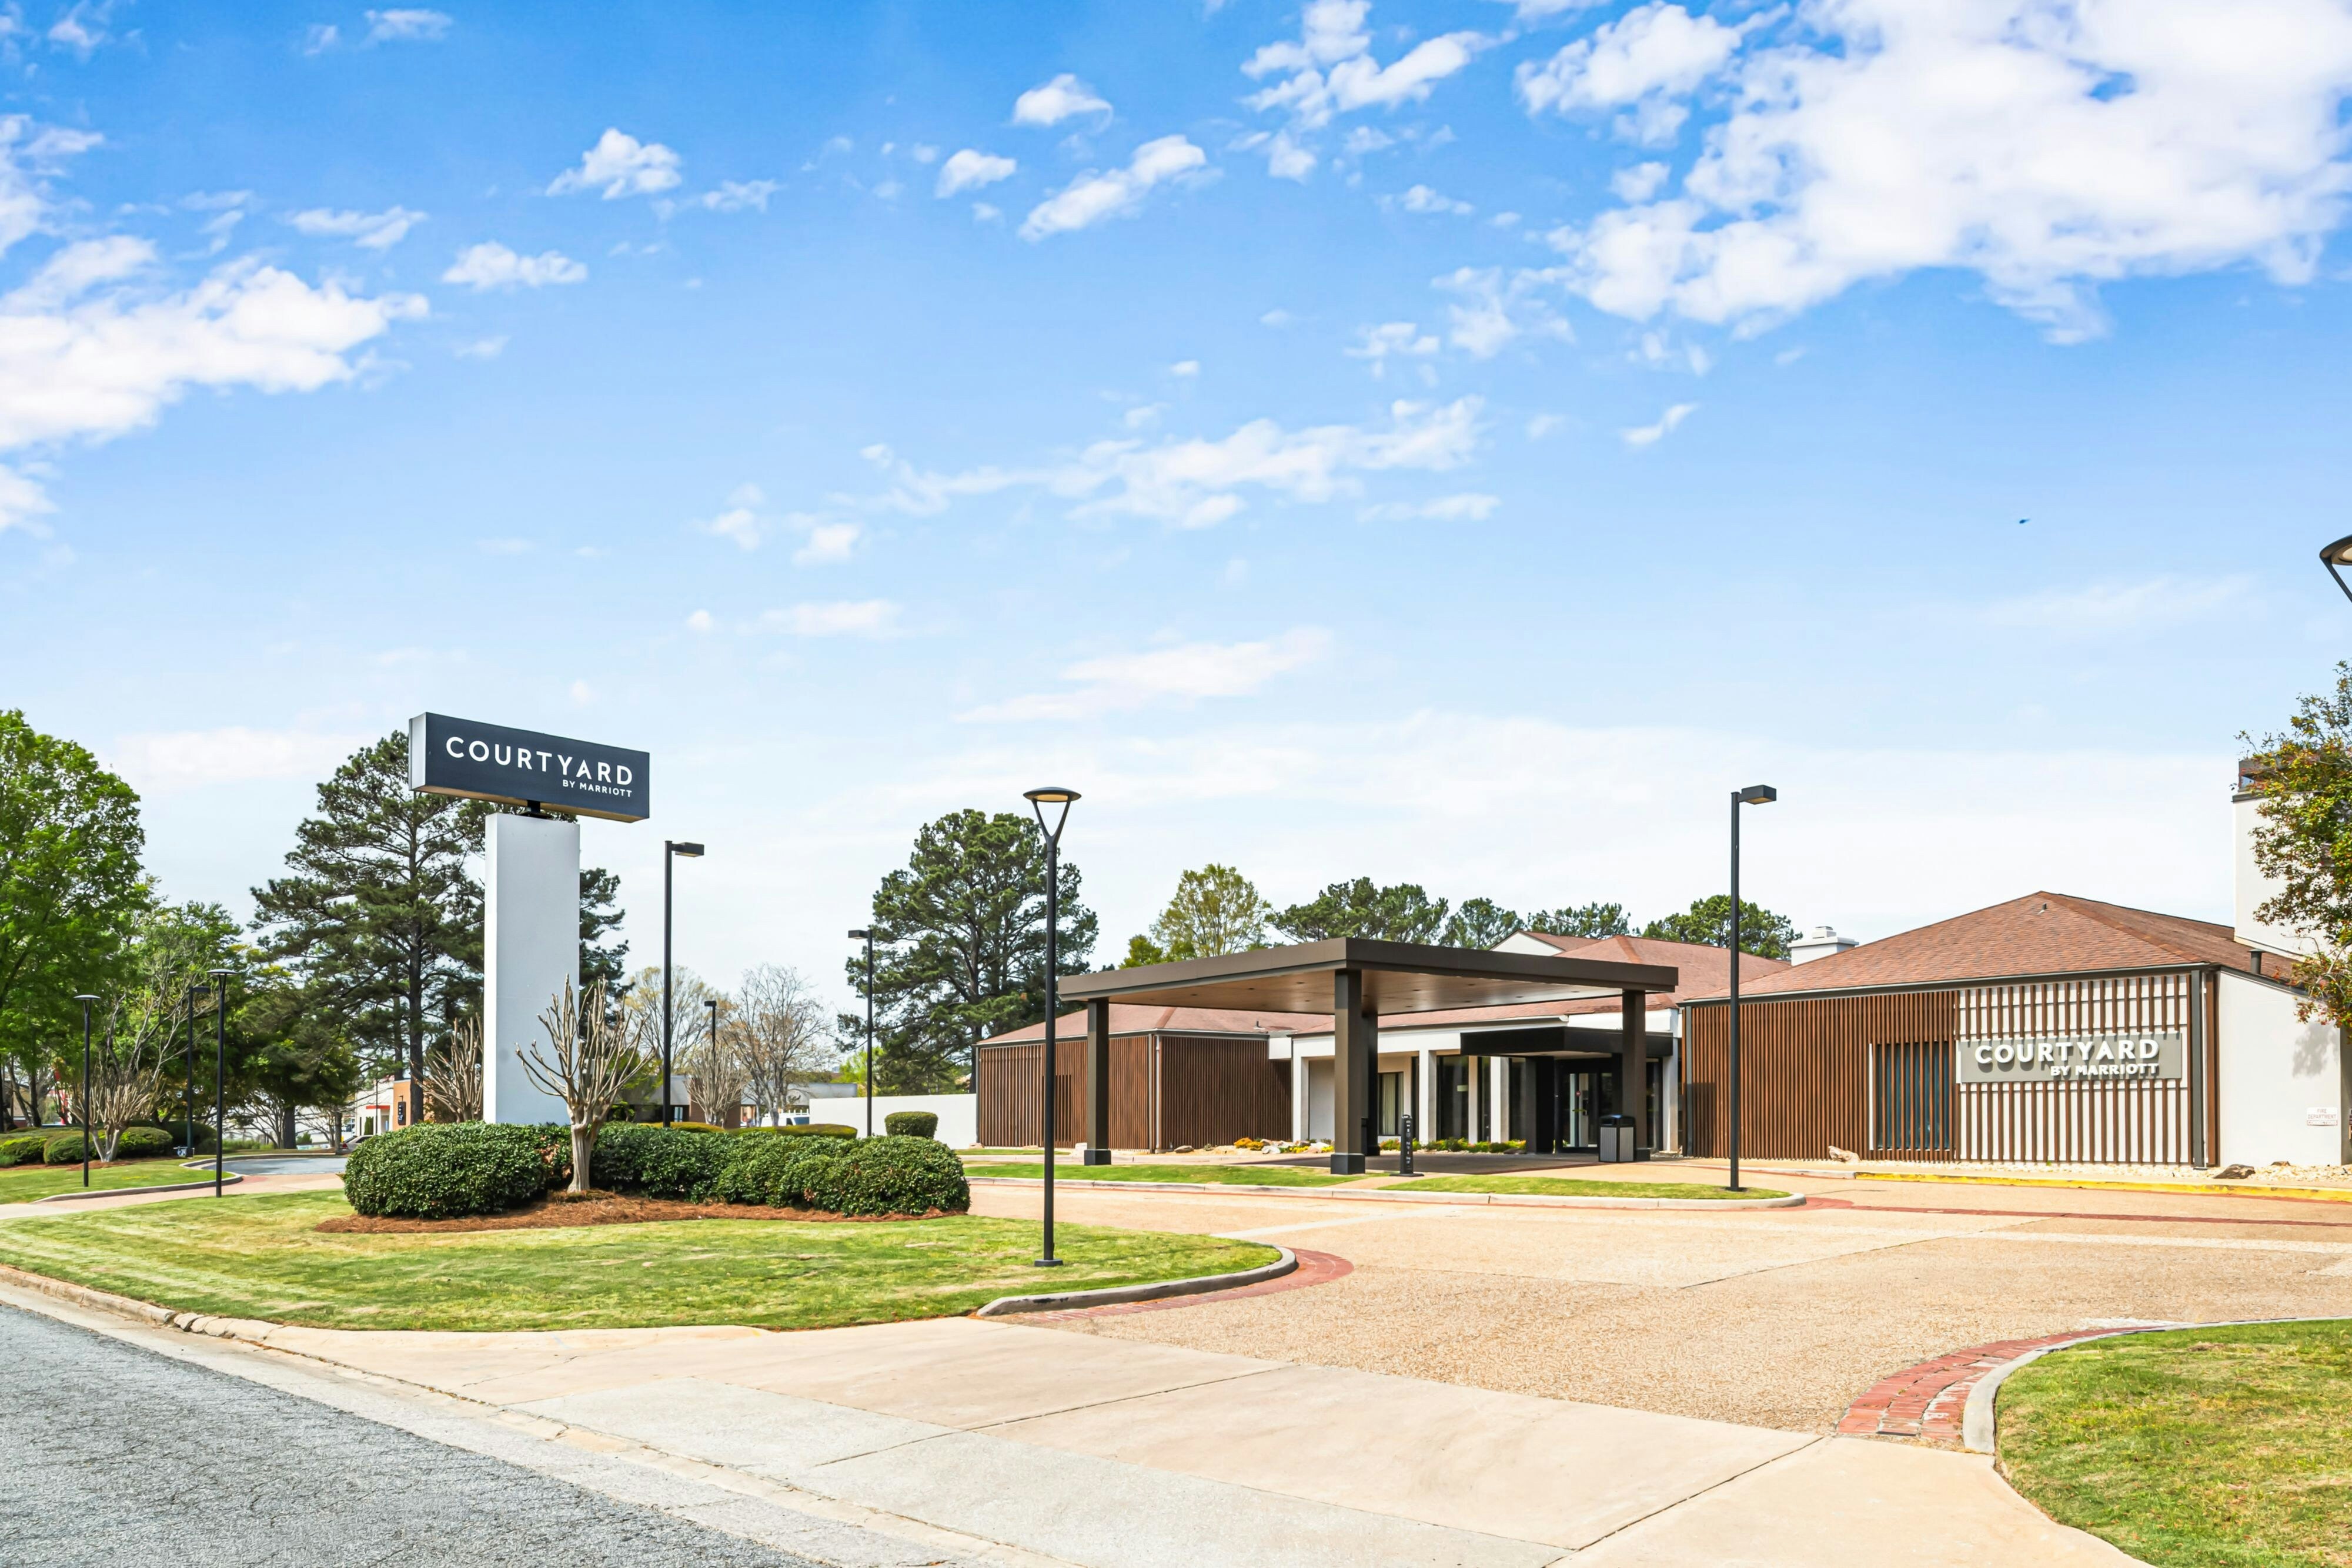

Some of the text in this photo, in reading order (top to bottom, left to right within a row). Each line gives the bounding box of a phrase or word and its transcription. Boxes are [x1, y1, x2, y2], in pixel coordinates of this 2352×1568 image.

[446, 736, 633, 785] COURTYARD
[562, 780, 632, 797] BY MARRIOTT
[1975, 1039, 2159, 1064] COURTYARD
[2050, 1063, 2159, 1076] BY MARRIOTT
